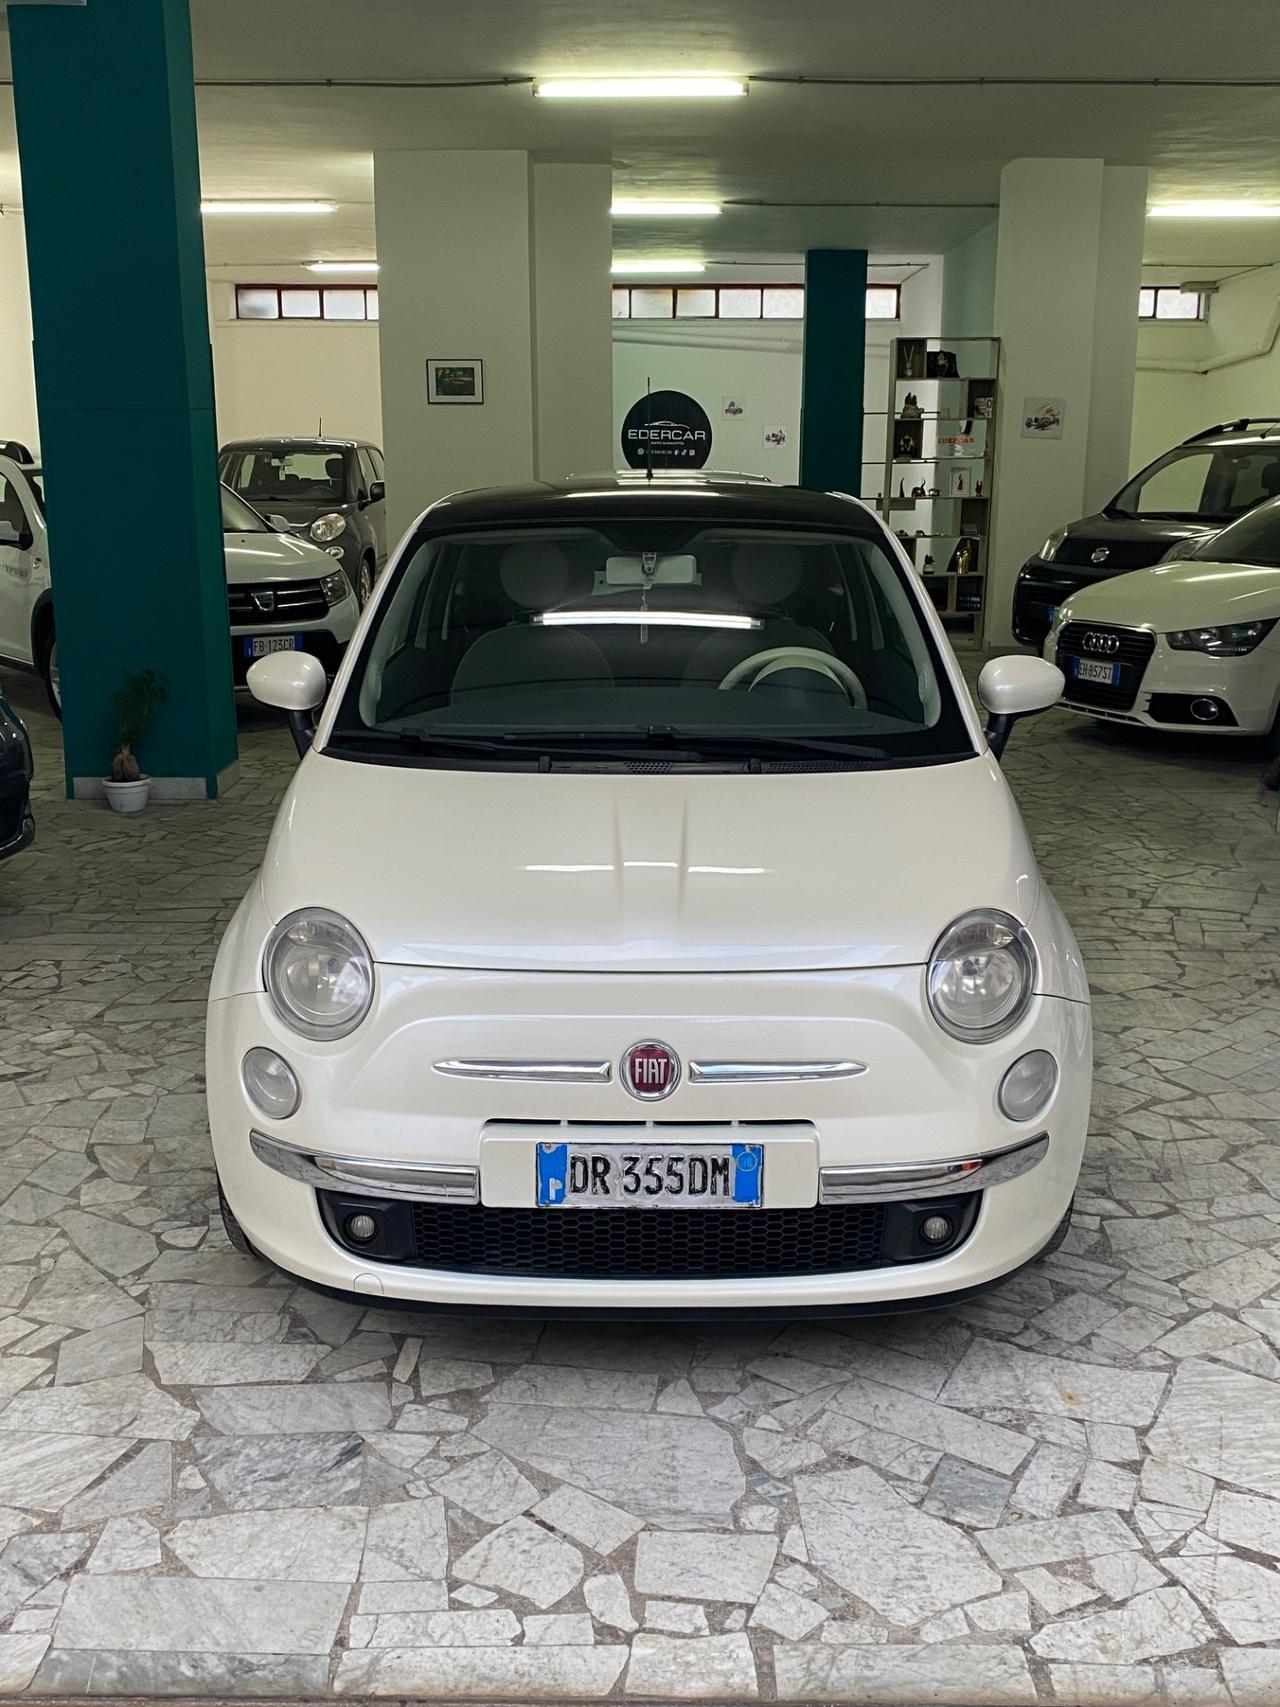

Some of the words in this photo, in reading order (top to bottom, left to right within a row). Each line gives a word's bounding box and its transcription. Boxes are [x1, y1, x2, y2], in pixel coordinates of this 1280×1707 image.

[627, 429, 706, 440] EDERCAR
[253, 640, 265, 652] FB
[1089, 665, 1112, 680] 857ST
[634, 1058, 668, 1085] FIAT
[569, 1154, 611, 1195] DR
[622, 1154, 730, 1196] 355DM
